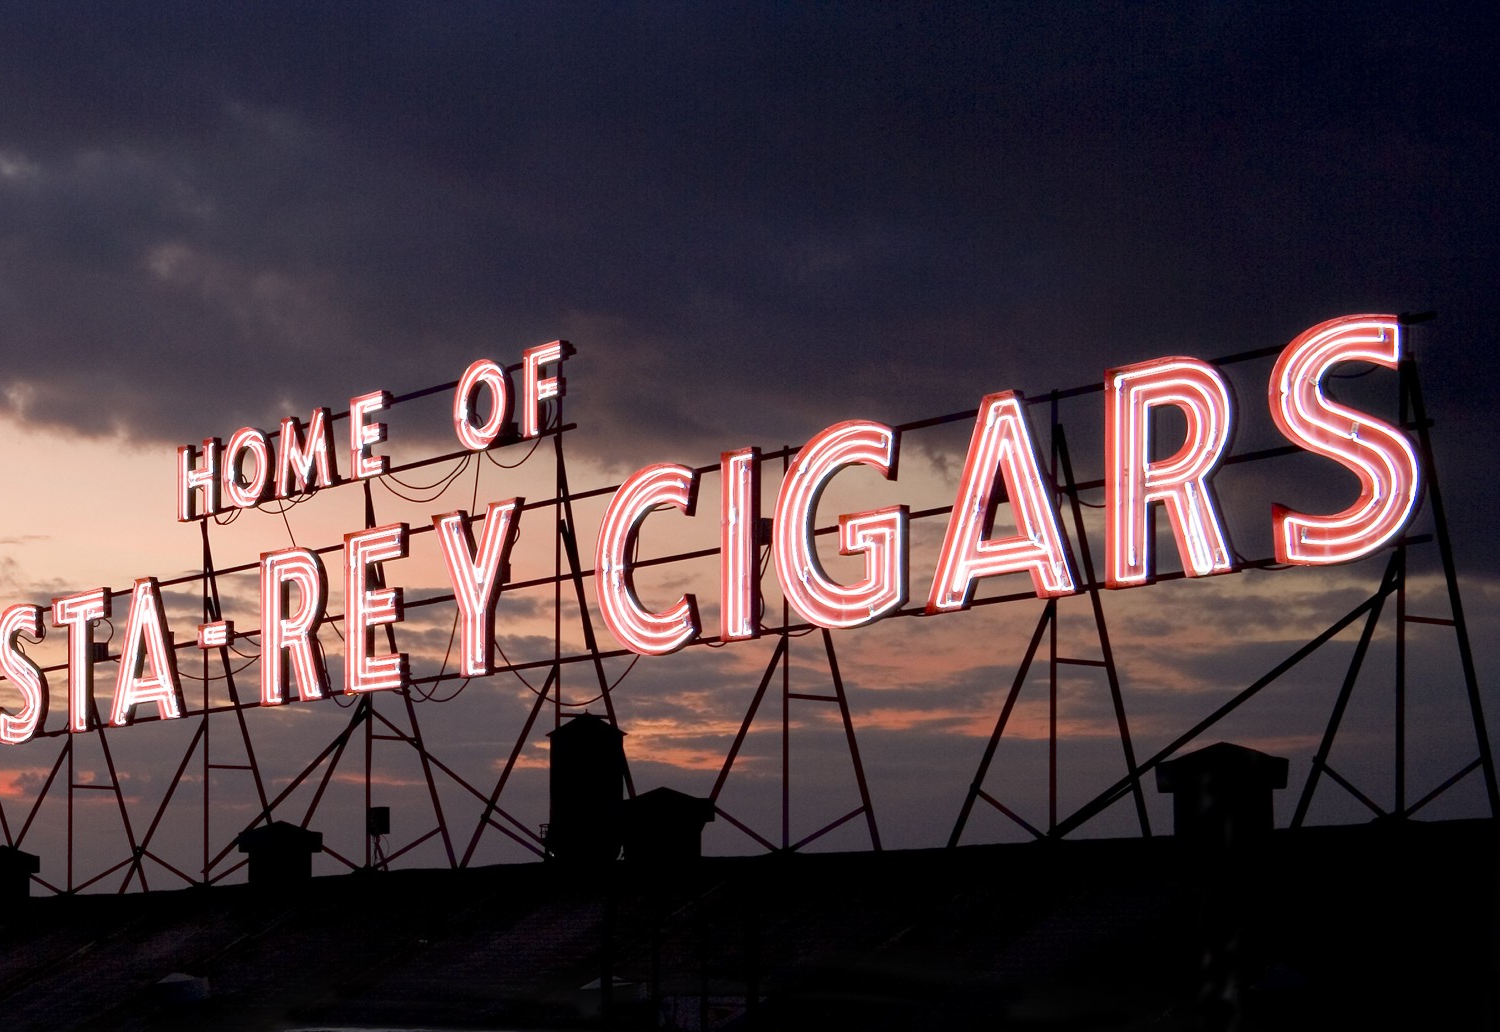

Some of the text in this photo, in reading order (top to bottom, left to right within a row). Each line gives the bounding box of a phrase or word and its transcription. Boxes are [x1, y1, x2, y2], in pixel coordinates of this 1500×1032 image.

[176, 339, 576, 523] HOME OF
[595, 312, 1422, 657] CIGARS
